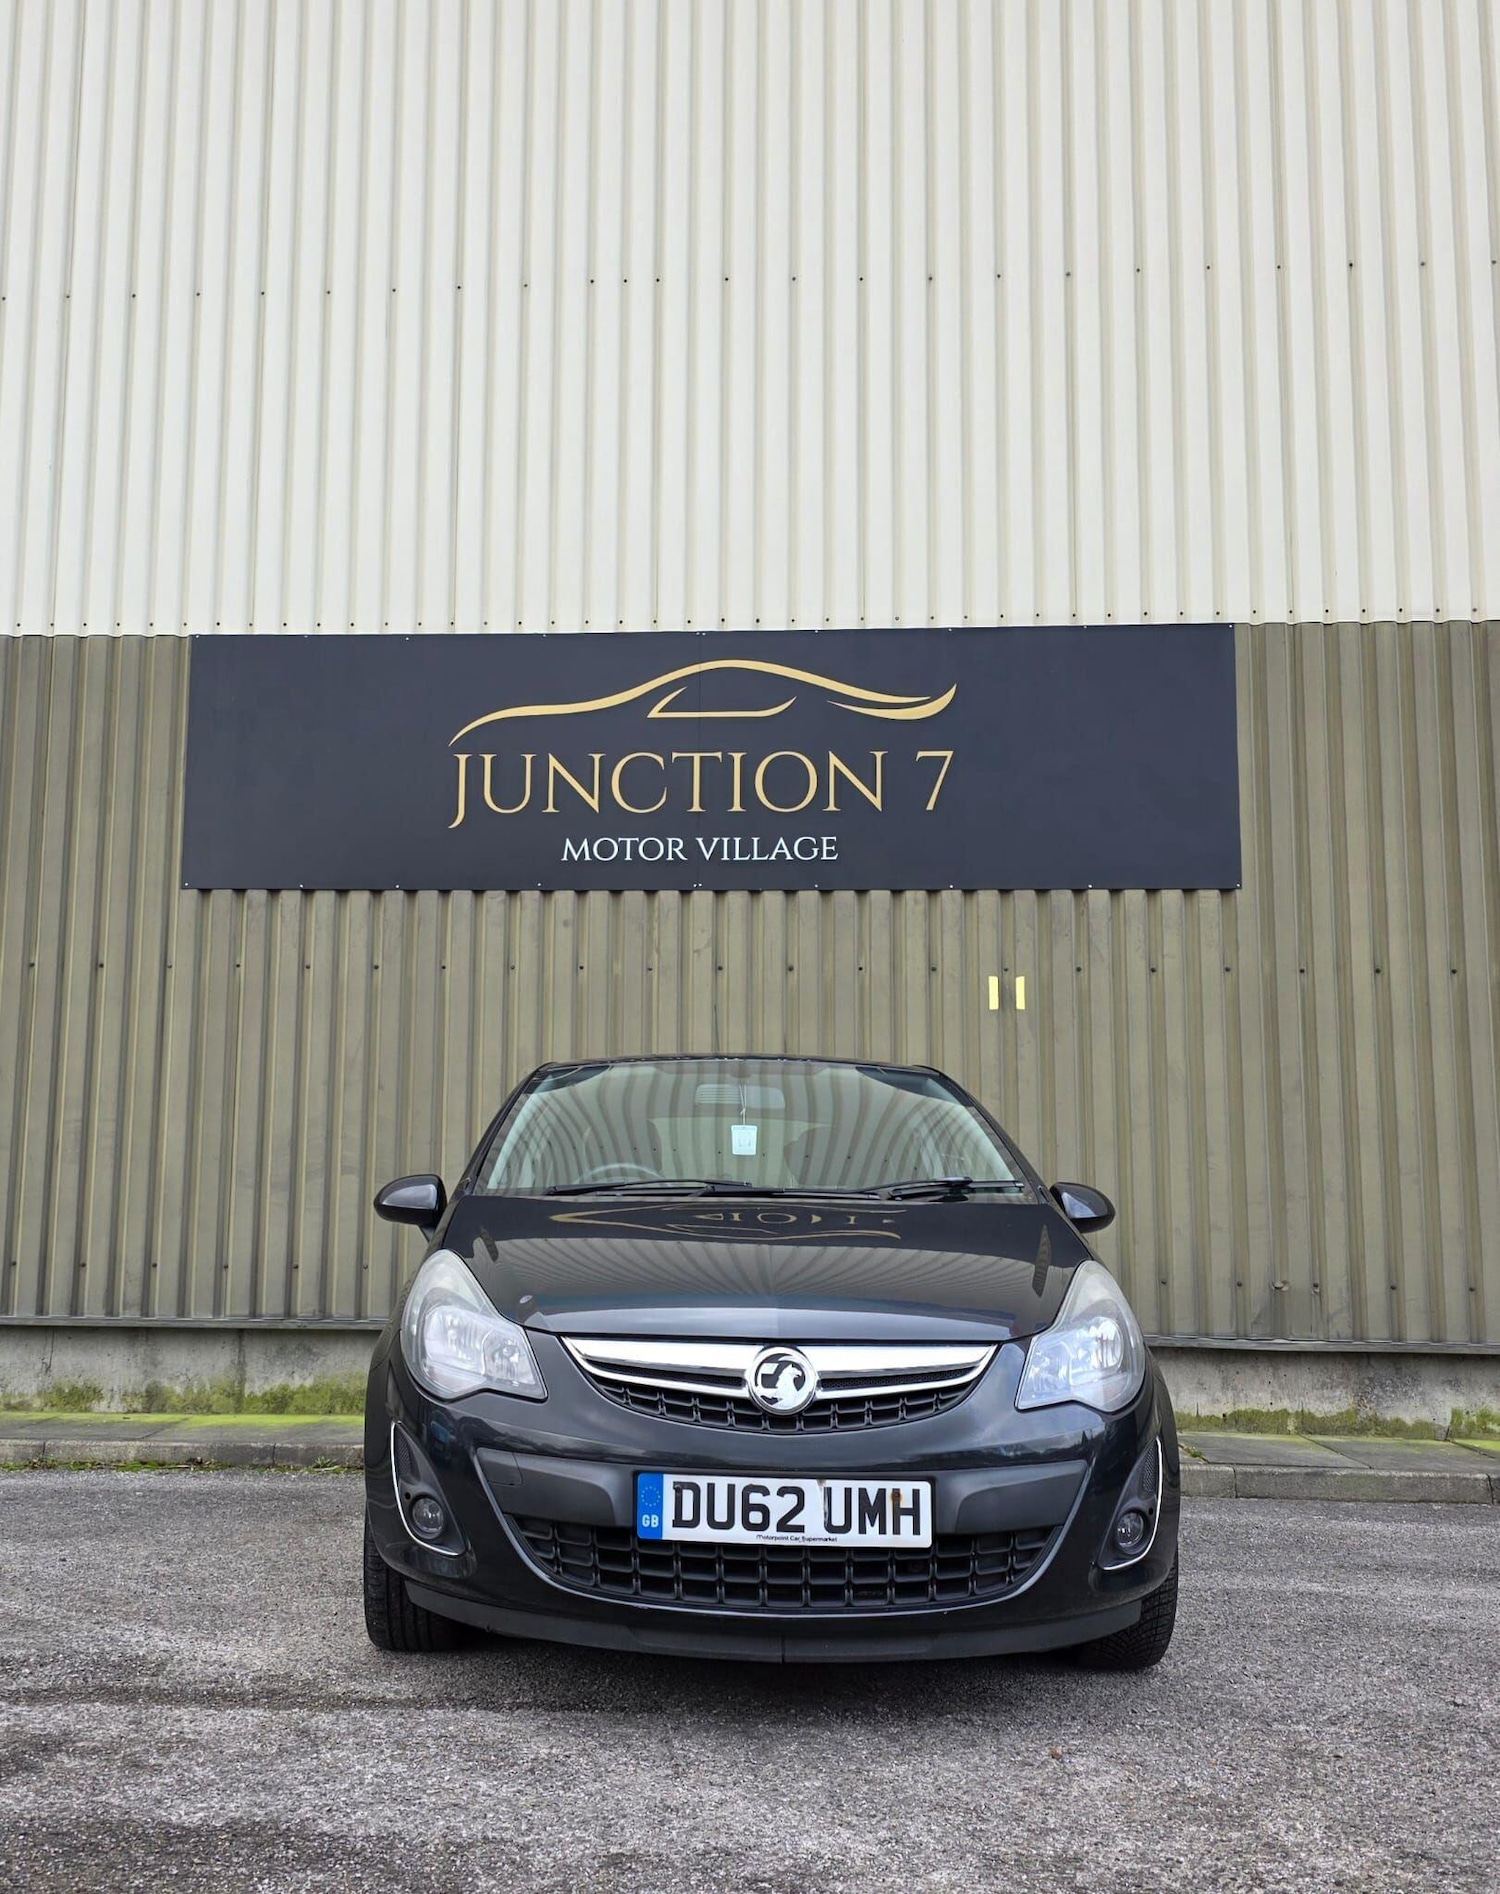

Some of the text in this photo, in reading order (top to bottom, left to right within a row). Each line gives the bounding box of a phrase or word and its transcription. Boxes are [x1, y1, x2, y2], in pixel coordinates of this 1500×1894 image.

[448, 749, 954, 829] JUNCTION 7
[561, 835, 838, 862] MOTOR VILLAGE
[641, 1514, 659, 1529] GB
[672, 1481, 921, 1536] DU62 UMH
[801, 1535, 838, 1543] Supermarket
